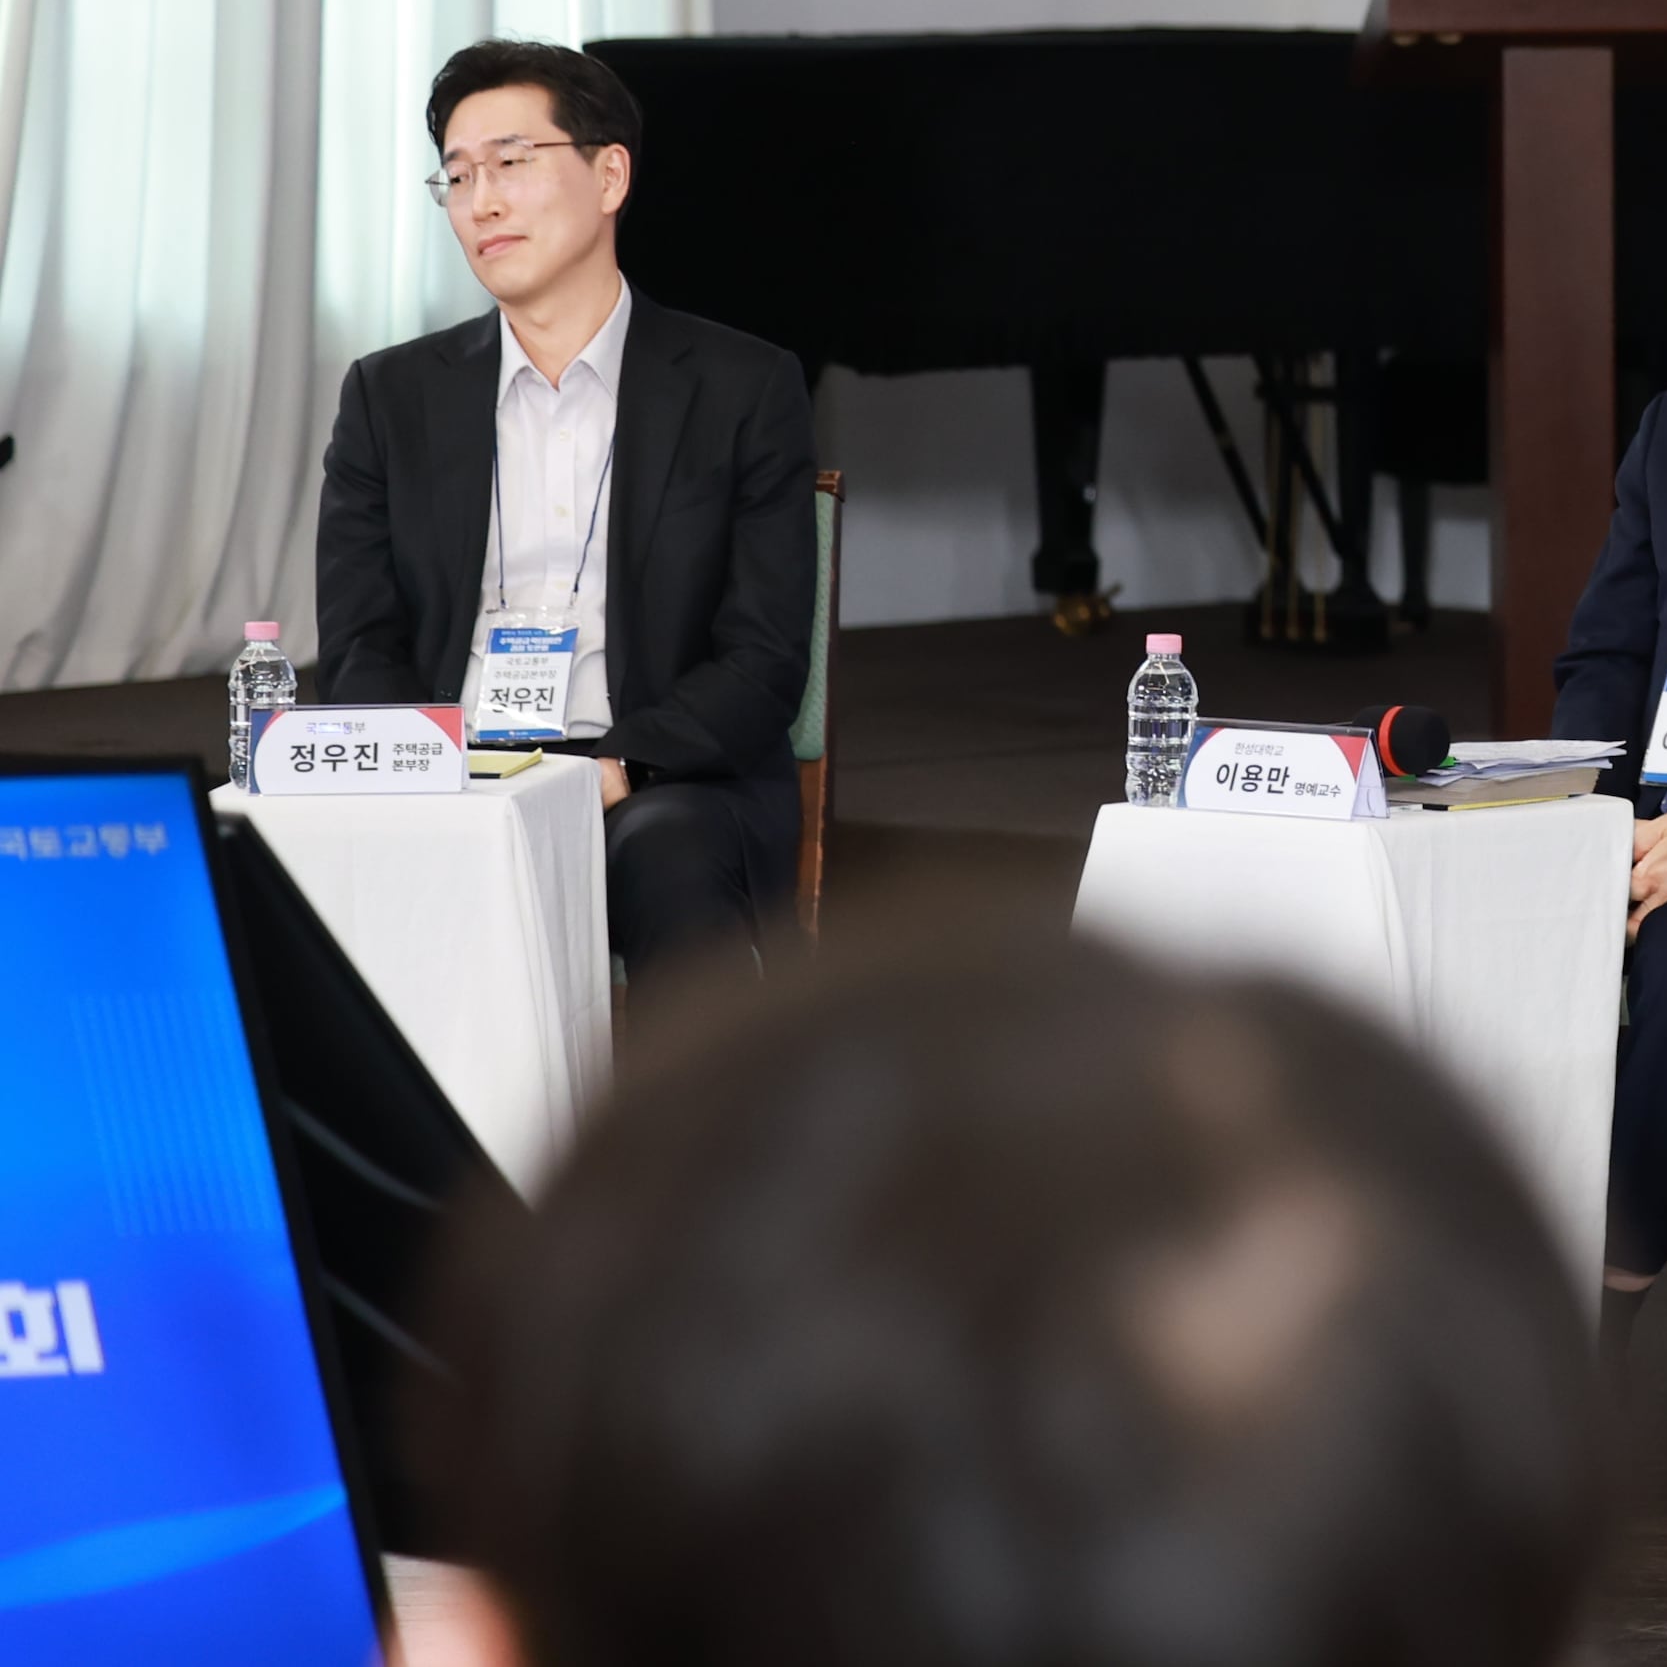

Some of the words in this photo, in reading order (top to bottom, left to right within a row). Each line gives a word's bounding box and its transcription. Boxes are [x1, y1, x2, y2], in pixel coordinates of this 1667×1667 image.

[489, 686, 556, 713] 정우진
[290, 742, 379, 773] 정우진
[392, 743, 443, 756] 주택공급
[1234, 742, 1285, 757] 한성대학교
[392, 759, 430, 772] 본부장
[1216, 762, 1290, 794] 이용만
[1294, 782, 1342, 798] 명예교수
